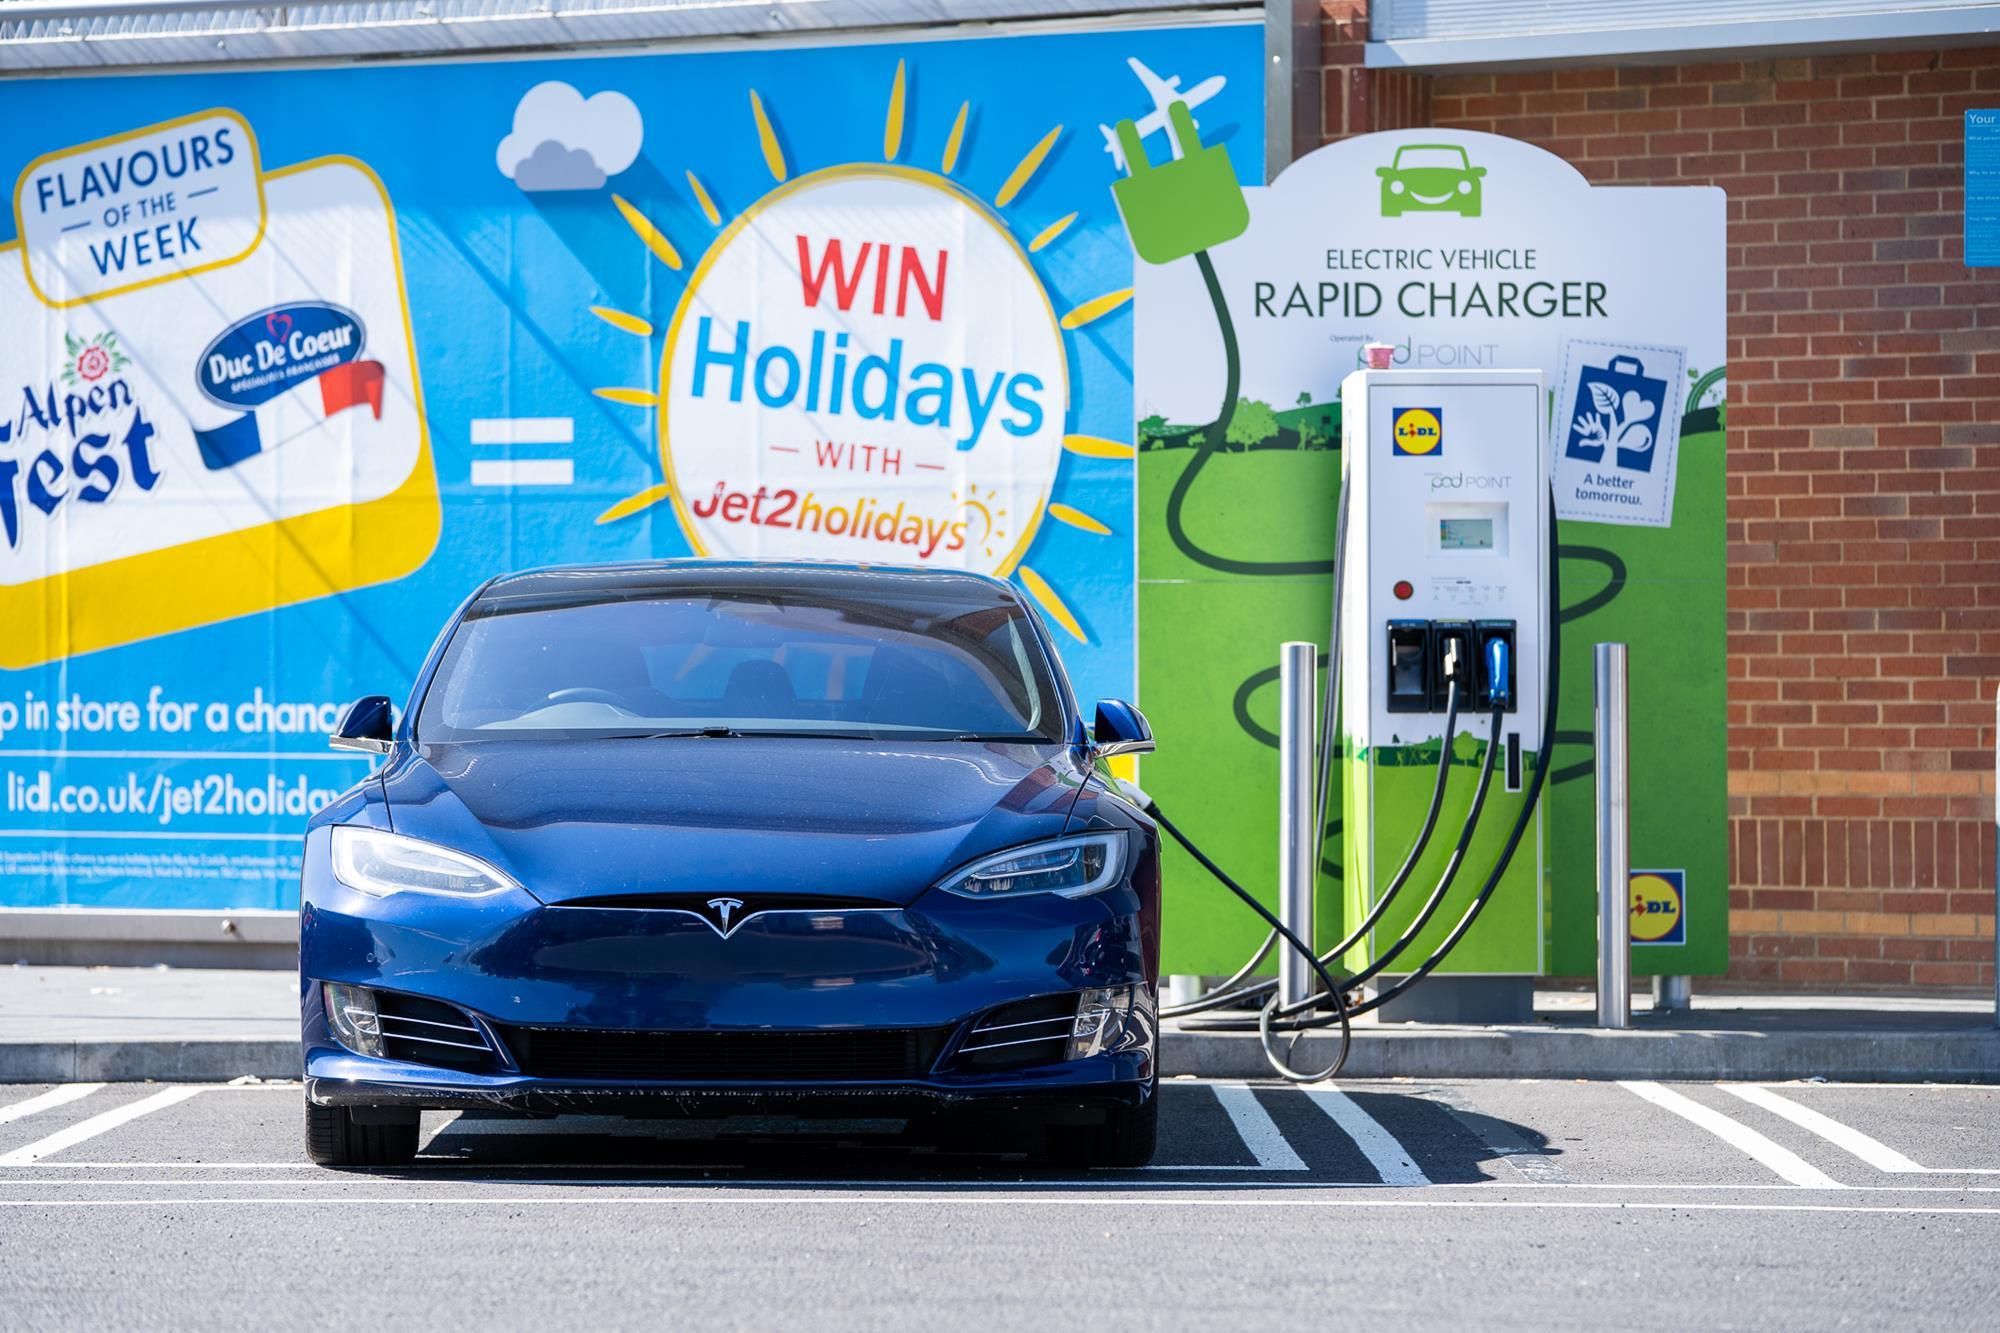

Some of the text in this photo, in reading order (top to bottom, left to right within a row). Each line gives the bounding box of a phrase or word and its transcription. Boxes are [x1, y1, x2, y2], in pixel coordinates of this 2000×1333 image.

[1969, 114, 1996, 124] Your
[37, 128, 235, 214] FLAVOURS
[103, 191, 176, 228] OF THE
[89, 216, 203, 275] WEEK
[1326, 249, 1537, 270] ELECTRIC VEHICLE
[797, 234, 949, 322] WIN
[1254, 281, 1609, 318] RAPID CHARGER
[208, 353, 254, 384] Duc
[255, 340, 287, 371] De
[288, 324, 353, 360] Coeur
[1357, 336, 1500, 370] pd POINT
[690, 315, 1045, 452] Holidays
[17, 379, 133, 438] Alpen
[815, 441, 901, 475] WITH
[1431, 472, 1512, 493] pod POINT
[1575, 487, 1643, 506] tomorrow.
[1583, 473, 1635, 489] A better
[25, 690, 49, 731] in
[56, 693, 140, 732] store
[148, 685, 199, 732] for
[205, 703, 230, 732] a
